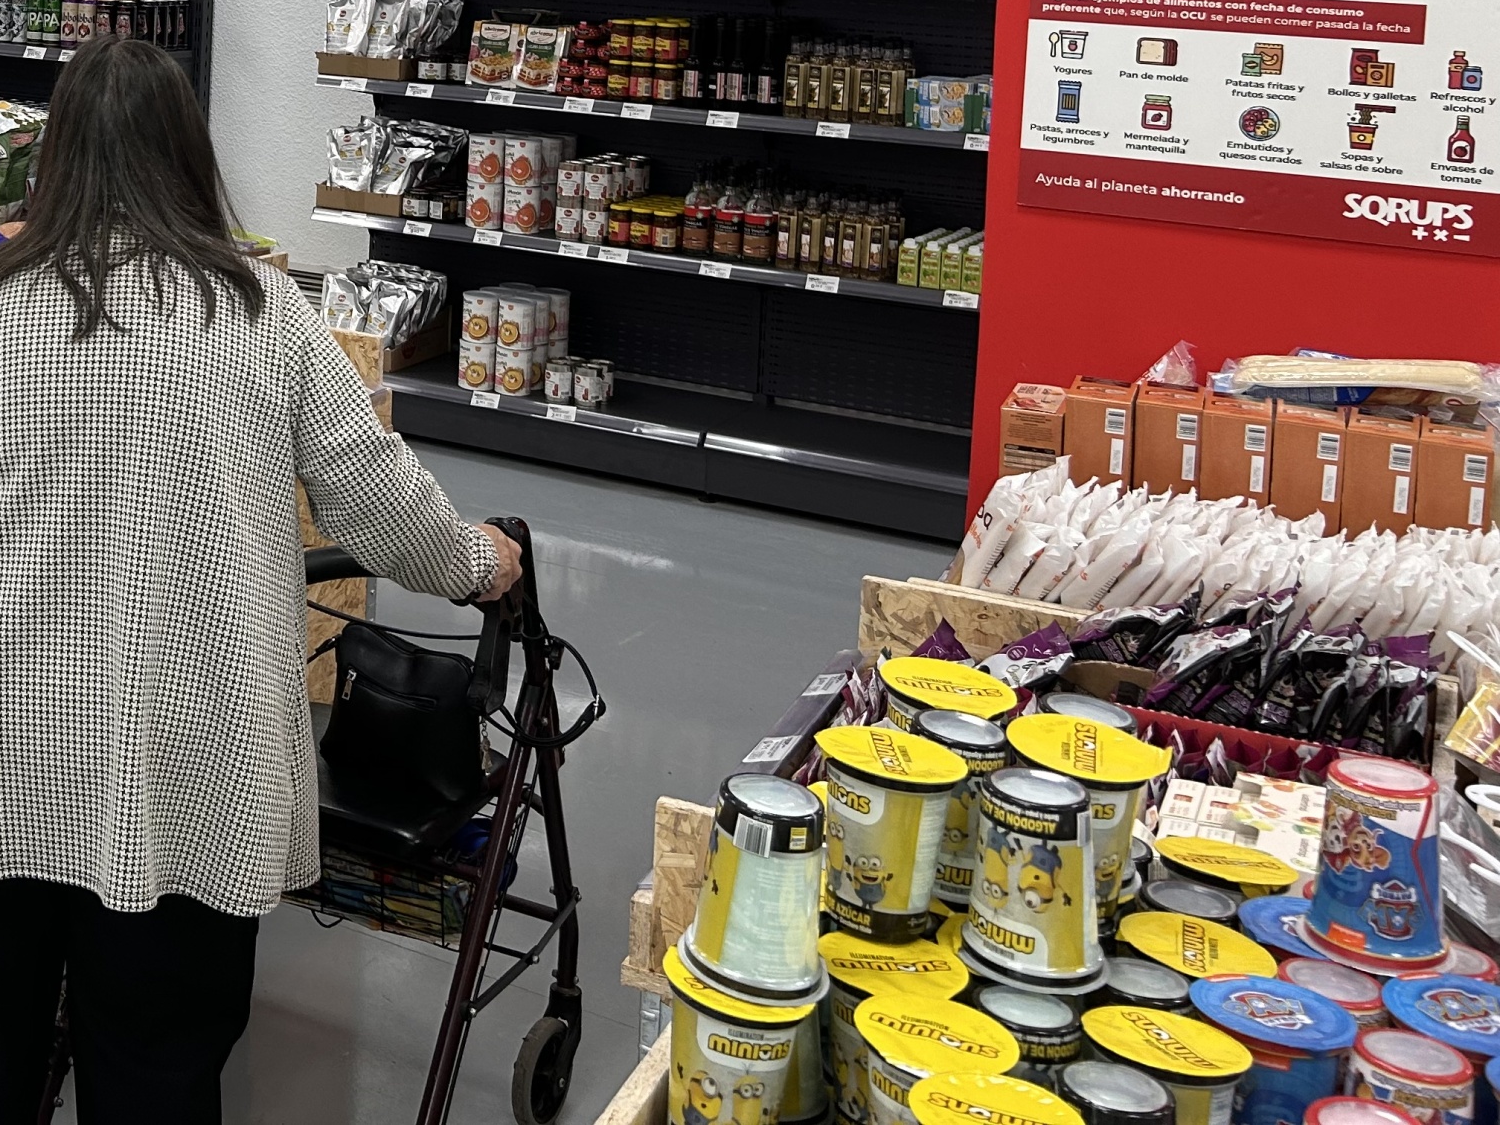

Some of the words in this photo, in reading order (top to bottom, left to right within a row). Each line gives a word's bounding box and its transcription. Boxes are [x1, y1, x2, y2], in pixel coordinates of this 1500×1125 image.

[1250, 2, 1284, 12] fecha
[1287, 5, 1303, 13] de
[1306, 7, 1364, 16] consumo
[1043, 3, 1101, 13] preferente
[1104, 8, 1127, 16] que,
[1130, 9, 1164, 18] según
[1168, 10, 1177, 18] la
[1180, 11, 1206, 20] OCU
[1226, 15, 1271, 24] pueden
[1316, 21, 1359, 29] pasada
[1363, 22, 1373, 30] la
[1377, 23, 1410, 33] fecha
[1054, 66, 1092, 75] Yogures
[1226, 79, 1265, 88] Patatas
[1268, 82, 1296, 91] fritas
[1232, 89, 1264, 98] frutos
[1328, 88, 1361, 97] Bollos
[1373, 93, 1417, 101] galletas
[1430, 92, 1486, 103] Refrescos
[1443, 104, 1484, 113] alcohol
[1030, 124, 1063, 134] Pastas,
[1043, 134, 1095, 145] legumbres
[1124, 132, 1180, 143] Mermelada
[1126, 143, 1186, 155] mantequilla
[1227, 141, 1284, 153] Embutidos
[1219, 152, 1257, 160] quesos
[1259, 156, 1302, 165] curados
[1341, 153, 1374, 162] Sopas
[1320, 161, 1352, 170] salsas
[1372, 166, 1403, 174] sobre
[1431, 163, 1476, 173] Envases
[1479, 167, 1494, 175] de
[1441, 175, 1482, 184] tomate
[1036, 173, 1080, 187] Ayuda
[1085, 179, 1097, 188] al
[1102, 180, 1157, 194] planeta
[1162, 186, 1244, 203] ahorrando
[1342, 193, 1474, 230] SQRUPS
